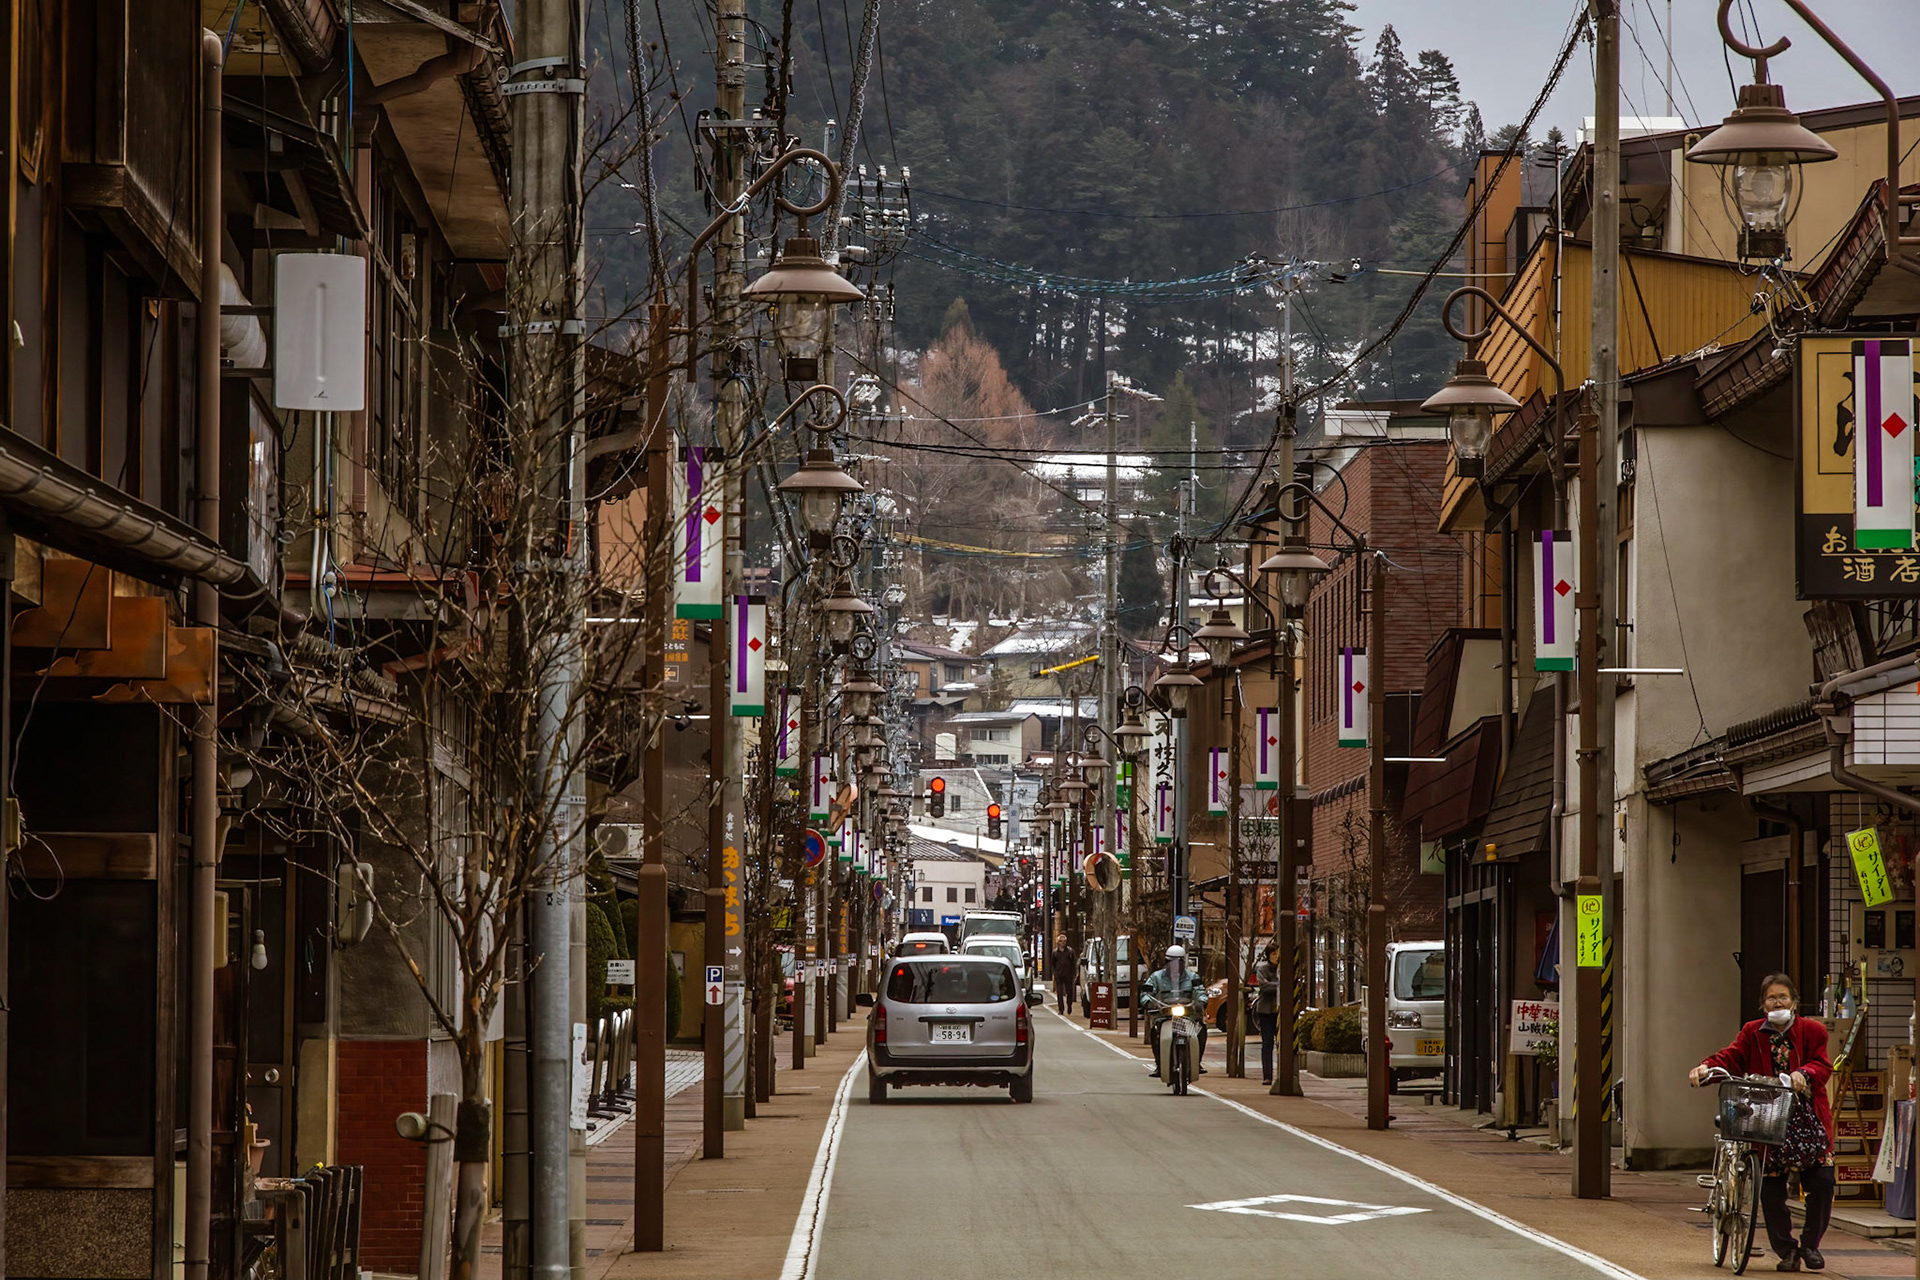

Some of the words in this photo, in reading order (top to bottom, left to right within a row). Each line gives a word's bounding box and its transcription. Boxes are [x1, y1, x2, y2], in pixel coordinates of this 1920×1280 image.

[1843, 556, 1920, 582] 酒店
[1868, 851, 1886, 897] サイダー
[1590, 917, 1601, 961] サイダー
[710, 969, 720, 980] P
[941, 1030, 967, 1040] 58-94
